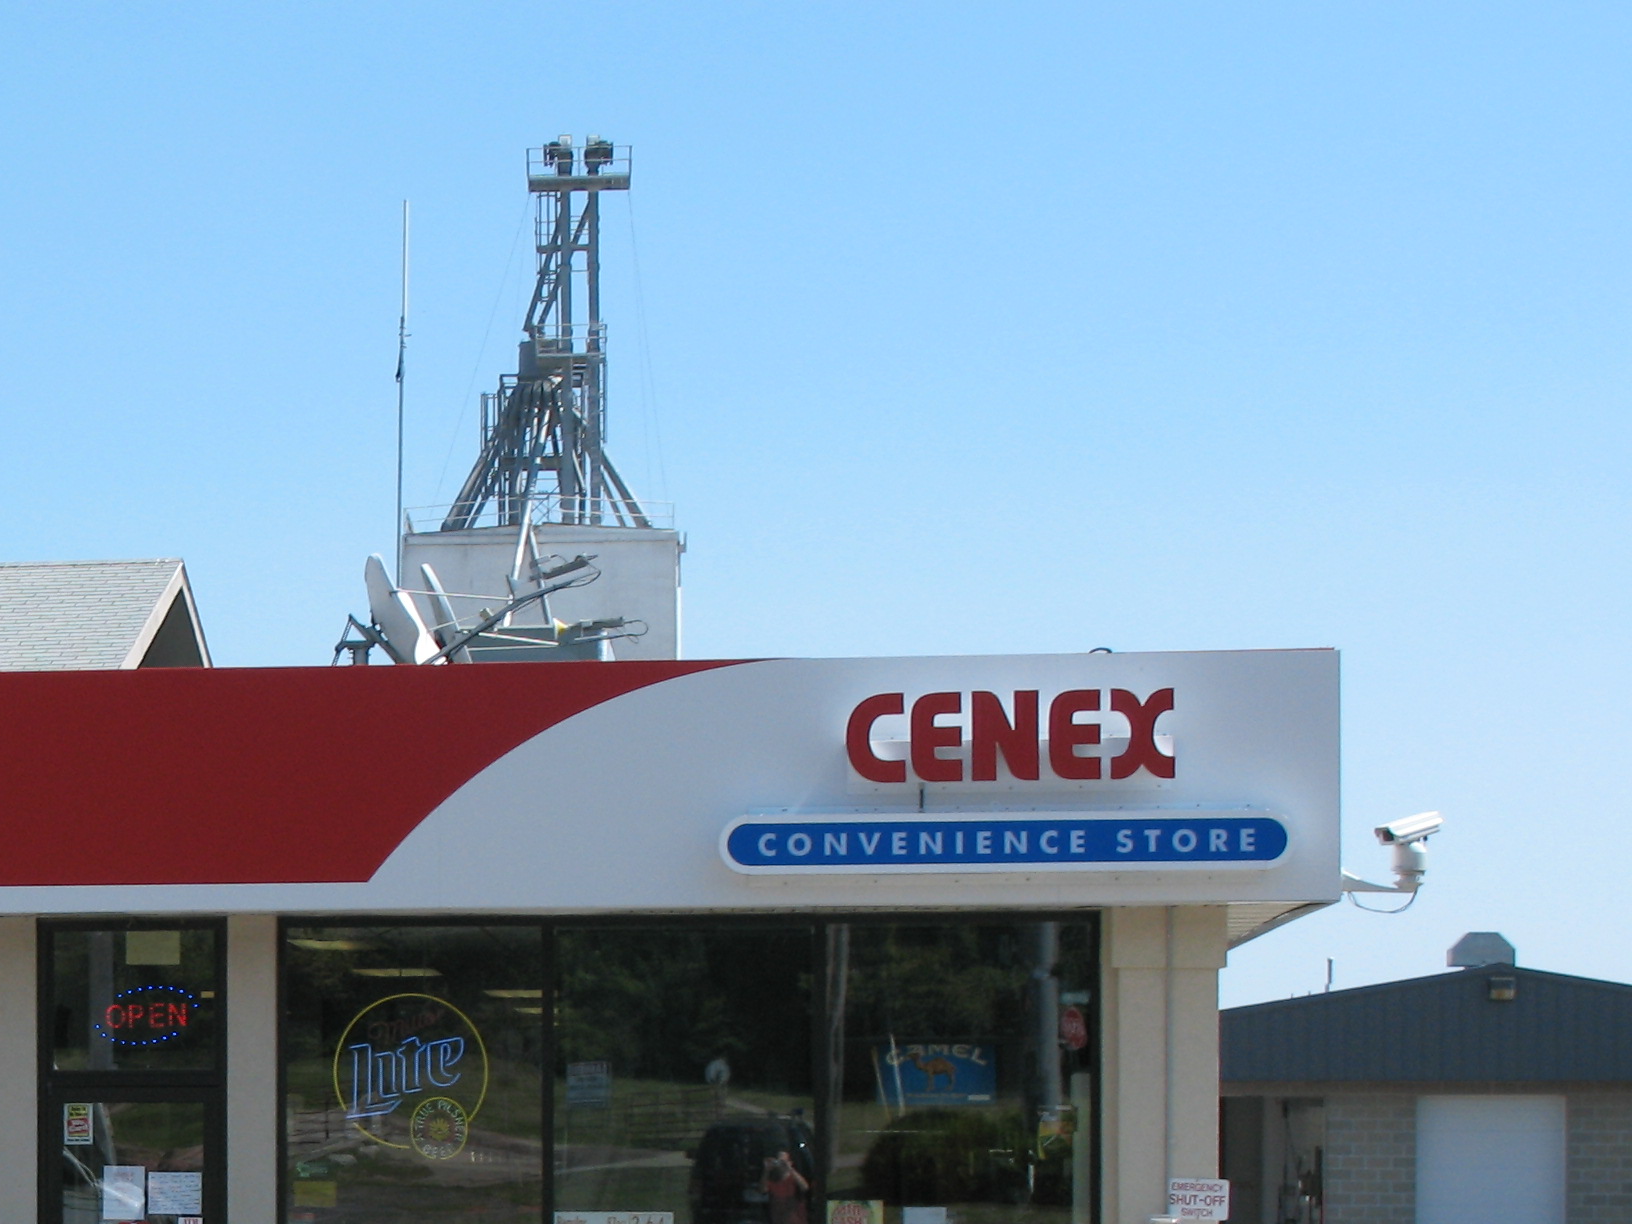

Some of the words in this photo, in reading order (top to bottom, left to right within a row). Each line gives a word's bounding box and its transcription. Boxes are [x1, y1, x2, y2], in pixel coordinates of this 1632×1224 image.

[846, 687, 1176, 783] CENEX
[758, 829, 1086, 858] CONVENIENCE
[1116, 827, 1257, 853] STORE
[105, 1003, 188, 1029] OPEN
[885, 1043, 988, 1067] CAMEL
[345, 1036, 465, 1119] Lite
[415, 1104, 435, 1131] TRUE
[437, 1099, 466, 1142] PILSNER
[1169, 1193, 1226, 1207] SHUT-OFF
[1171, 1182, 1224, 1193] EMERGENCY
[1181, 1208, 1214, 1217] SWITCH
